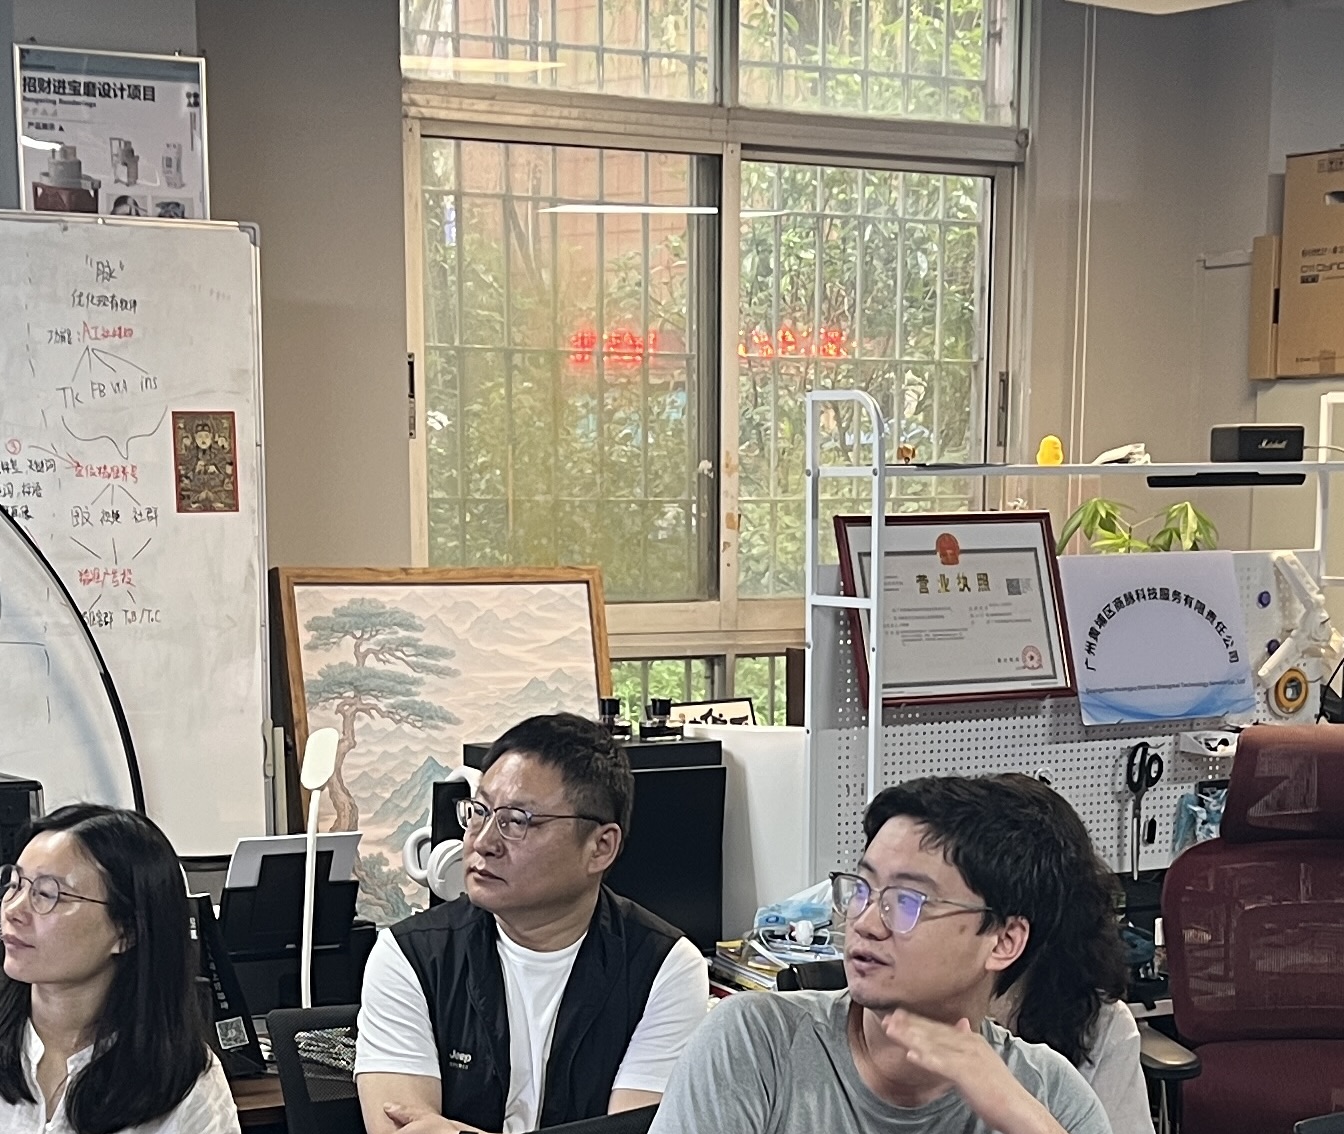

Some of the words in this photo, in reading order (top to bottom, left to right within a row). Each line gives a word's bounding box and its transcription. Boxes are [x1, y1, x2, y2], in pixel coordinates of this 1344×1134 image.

[916, 573, 991, 594] 营业执照
[449, 1049, 472, 1063] Jeep
